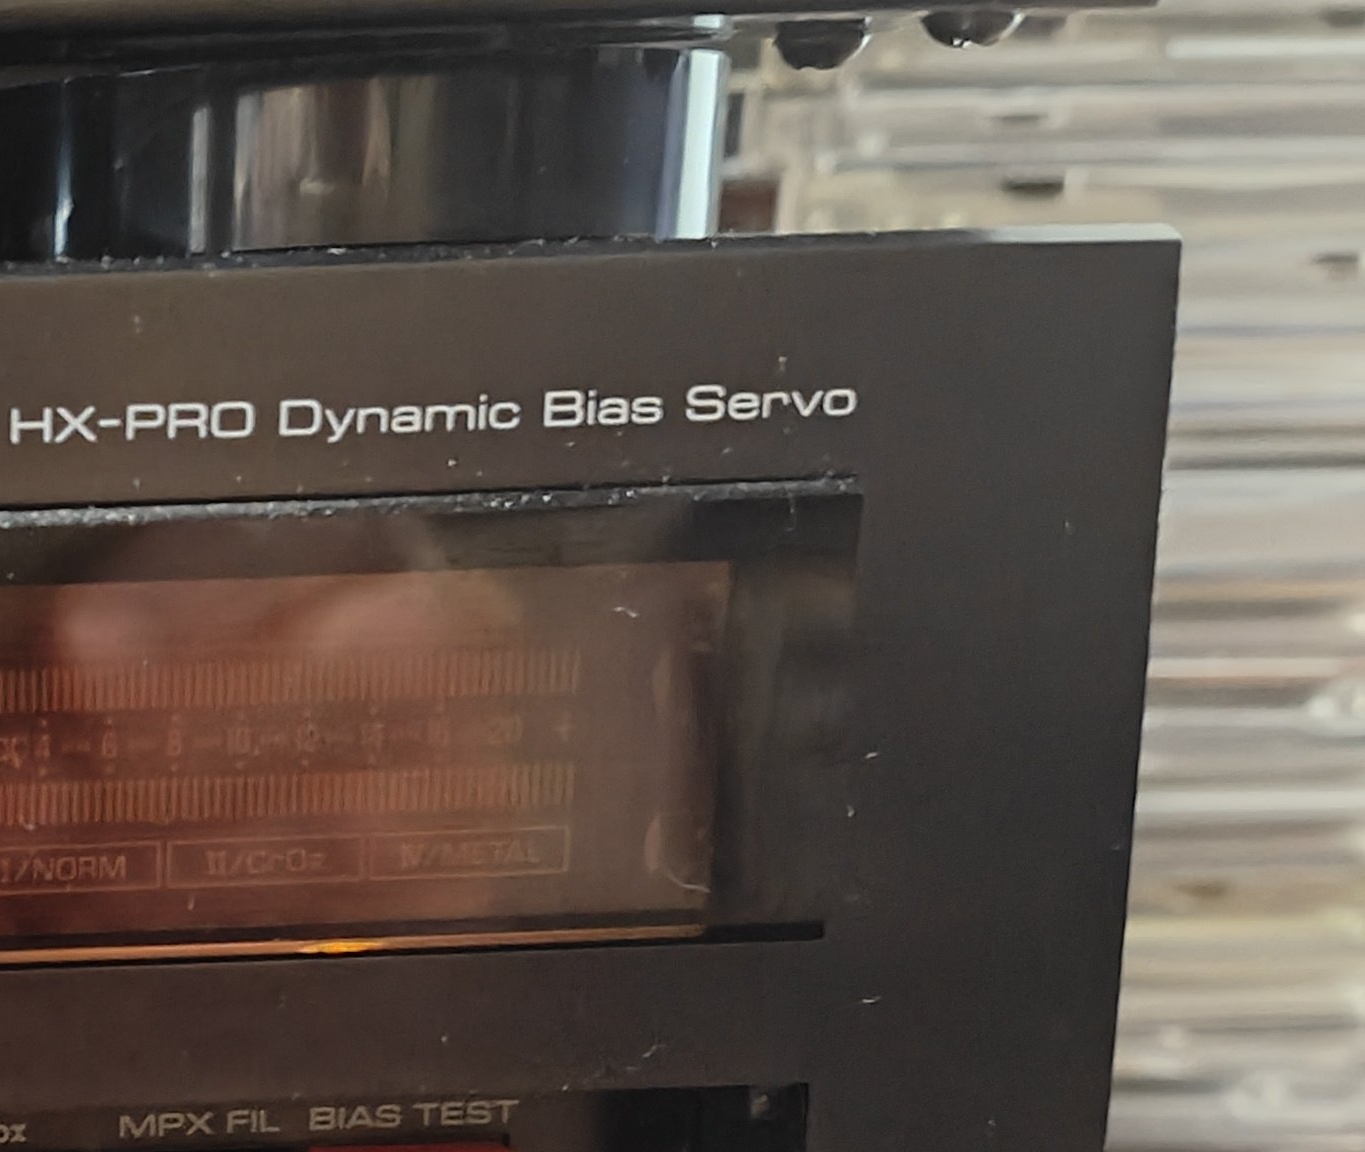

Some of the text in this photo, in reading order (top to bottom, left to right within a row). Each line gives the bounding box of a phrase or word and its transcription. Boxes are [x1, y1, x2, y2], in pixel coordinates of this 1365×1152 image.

[10, 385, 858, 444] HX-PRO Dynamic Bias Servo
[118, 1108, 280, 1138] MPX FIL
[308, 1099, 519, 1131] BIAS TEST
